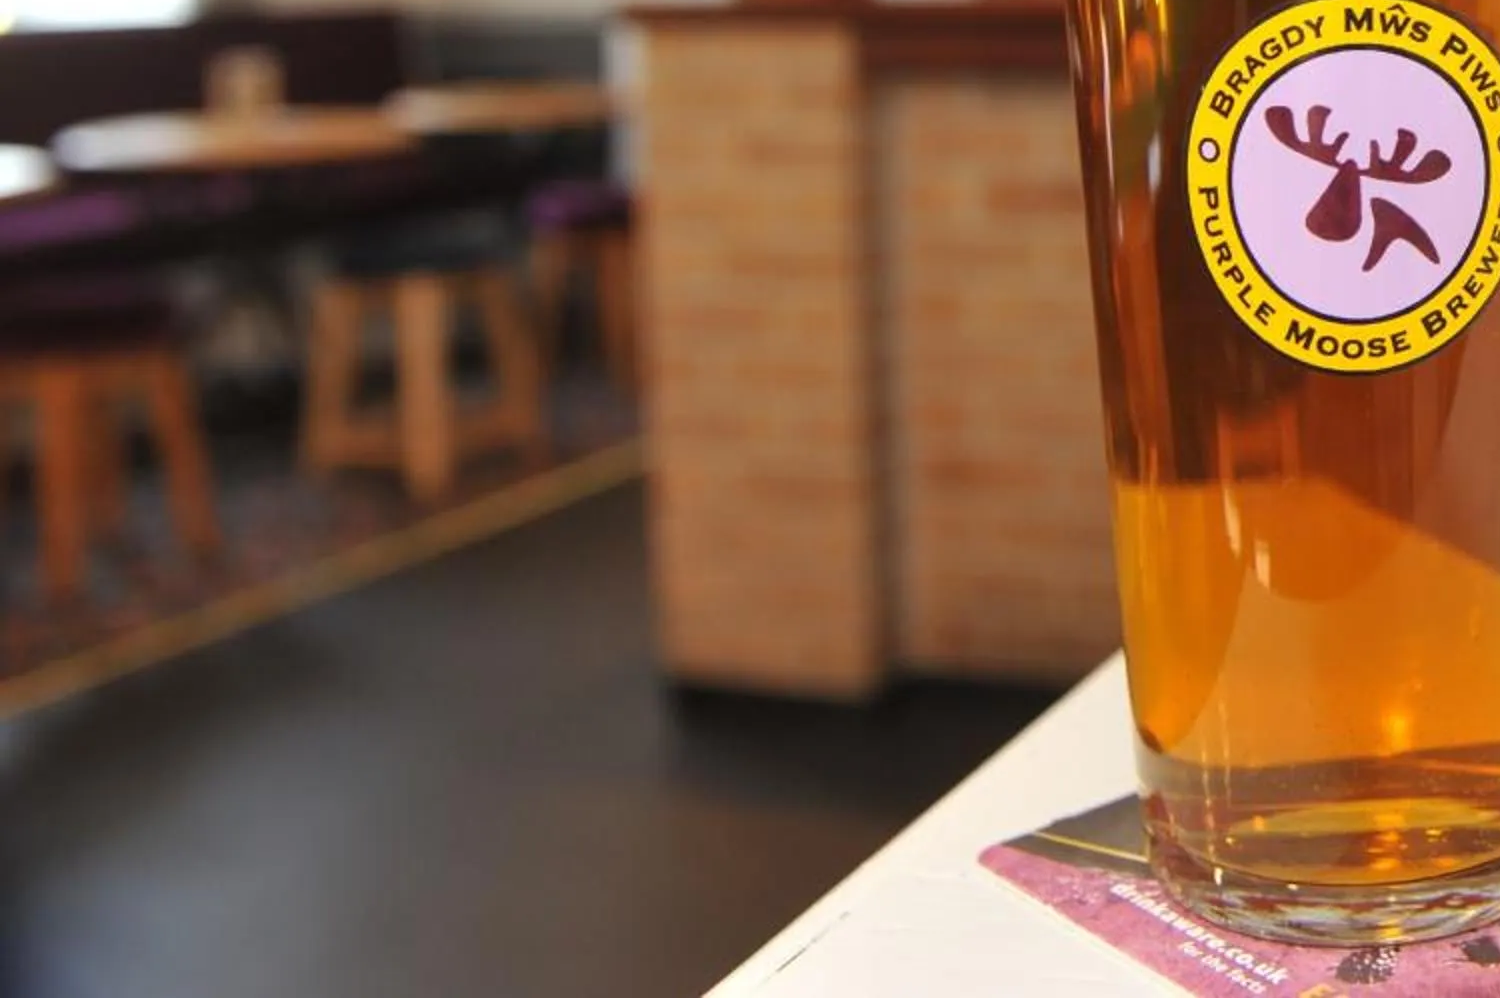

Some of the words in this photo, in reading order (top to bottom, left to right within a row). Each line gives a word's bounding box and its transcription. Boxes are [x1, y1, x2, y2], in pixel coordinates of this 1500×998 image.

[1209, 15, 1325, 119] BRAGDY
[1198, 186, 1276, 326] PURPLE
[1285, 320, 1412, 360] MOOSE
[1110, 882, 1289, 985] drinkaware.co.uk
[1201, 953, 1229, 974] the
